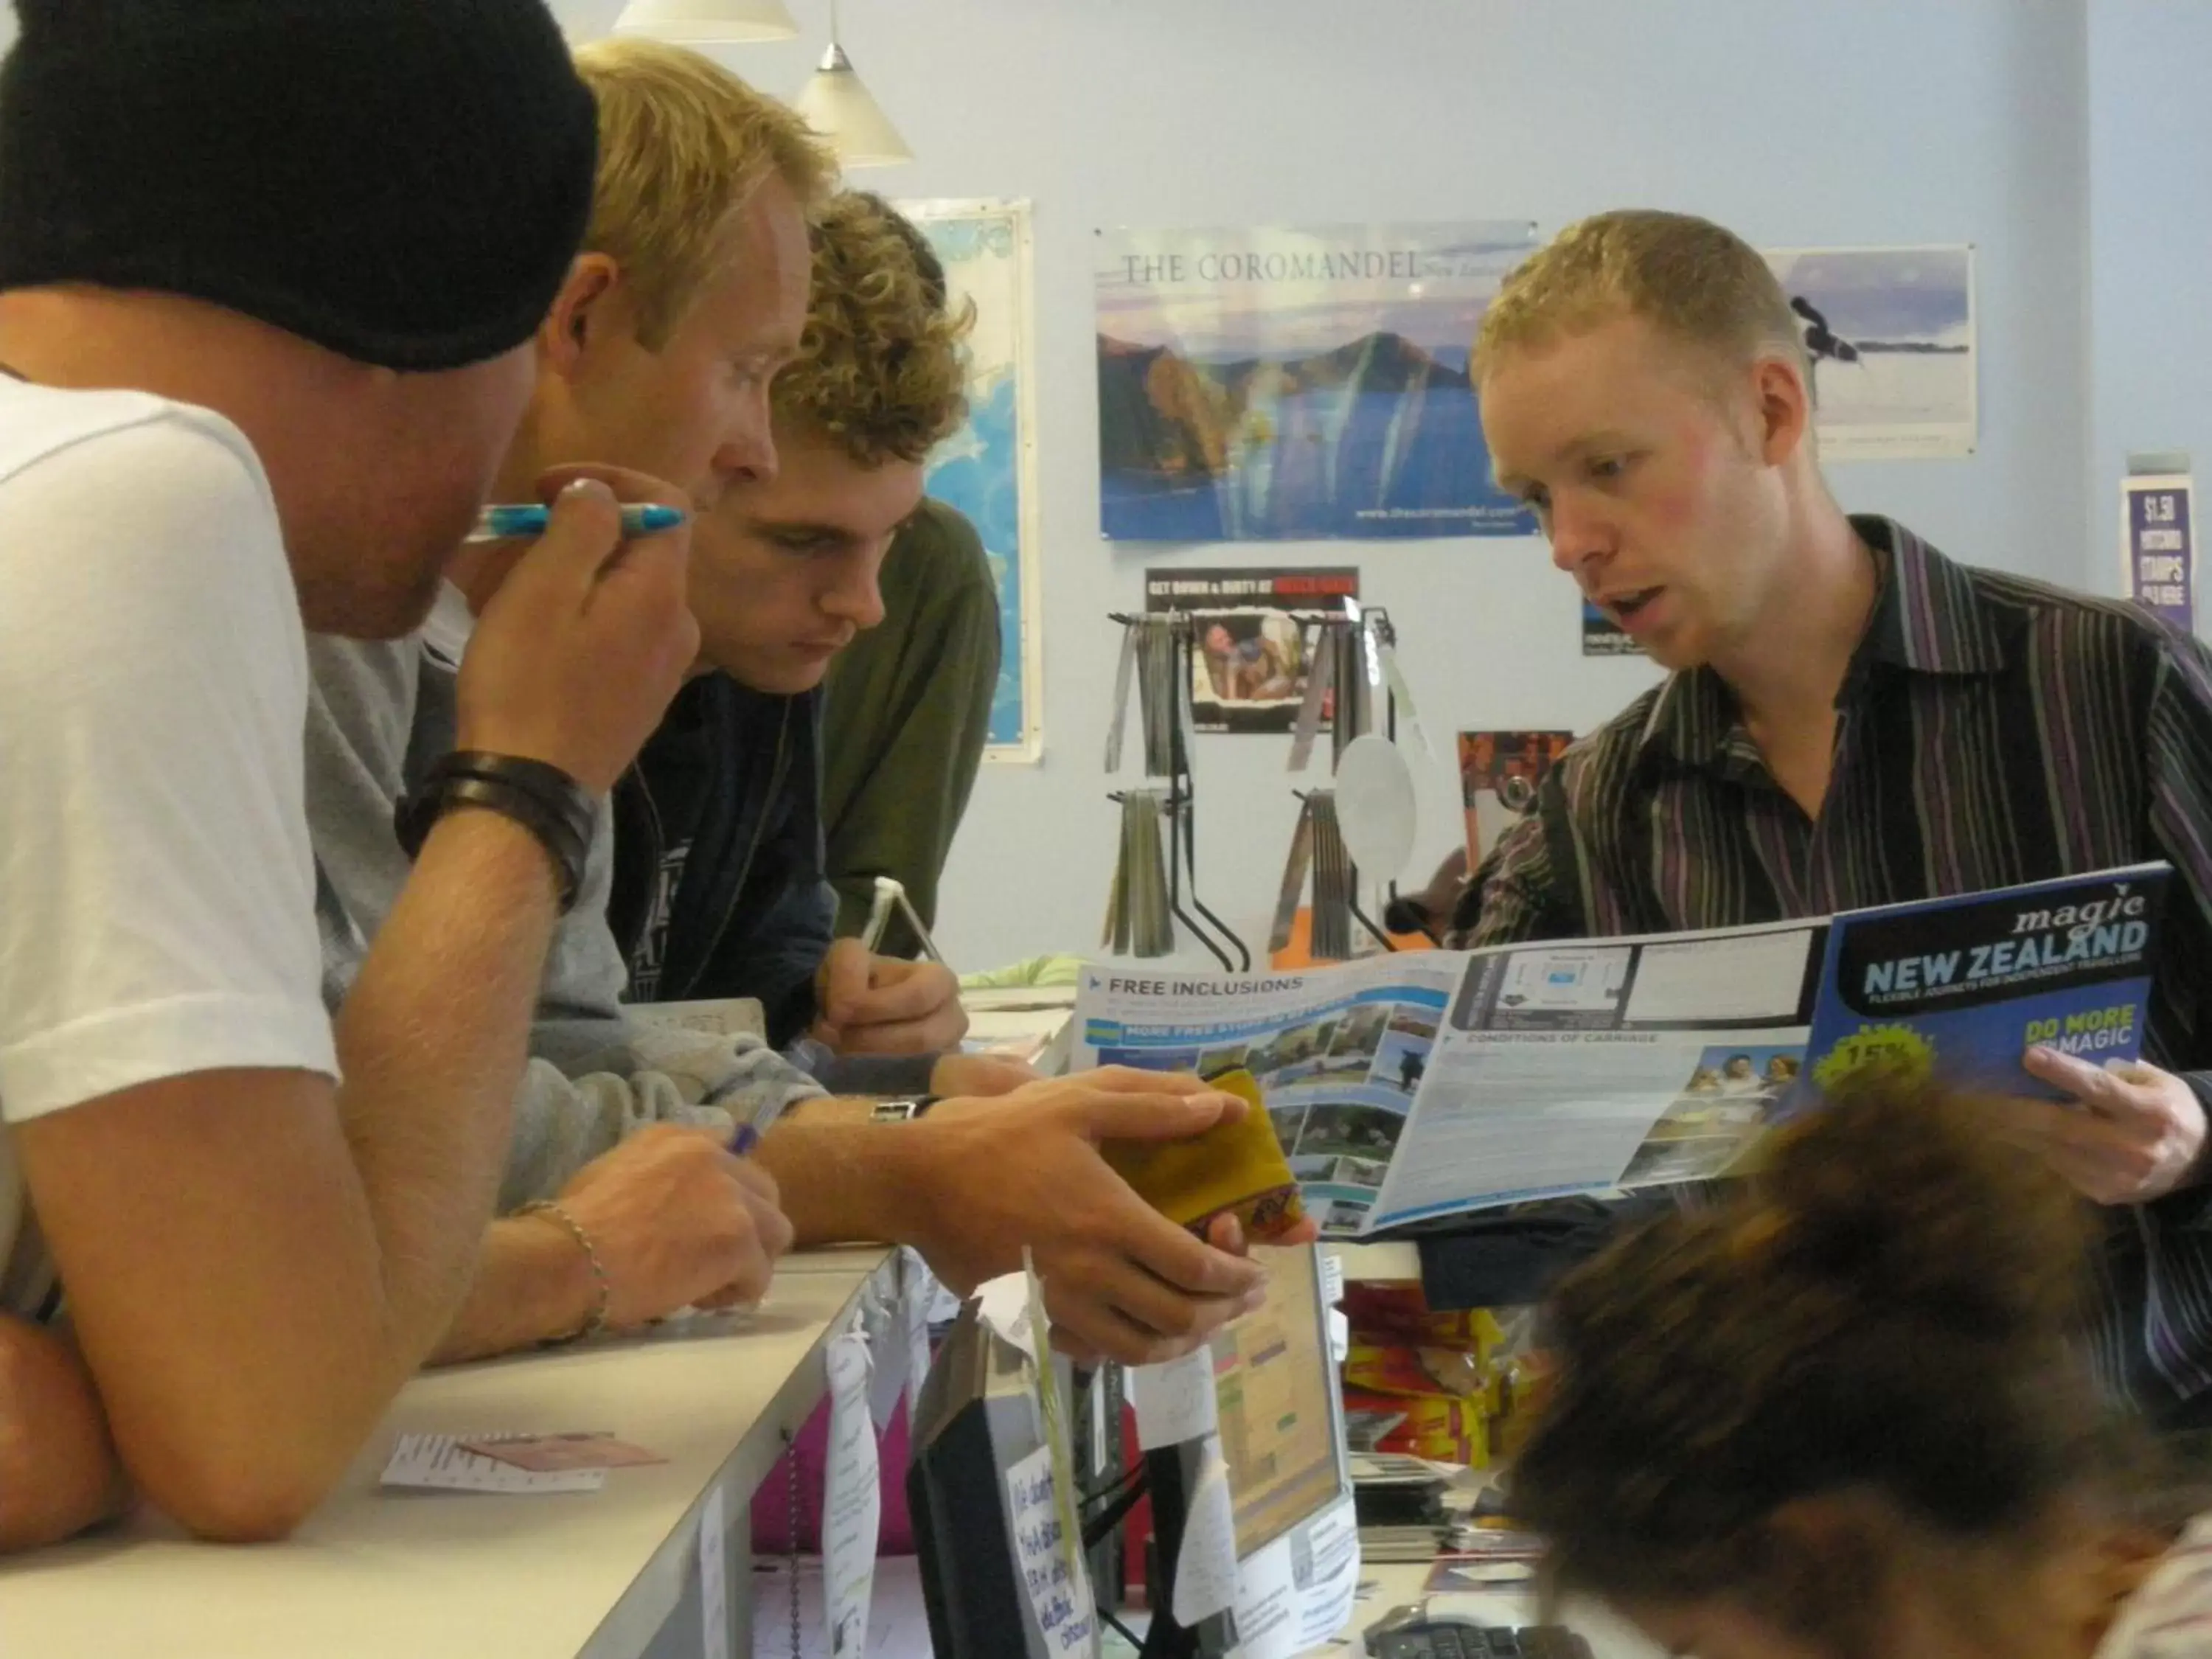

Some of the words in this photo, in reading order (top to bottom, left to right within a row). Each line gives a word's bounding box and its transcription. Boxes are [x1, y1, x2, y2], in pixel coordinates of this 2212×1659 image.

[1121, 254, 1186, 282] THE
[1198, 251, 1421, 282] COROMANDEL
[2011, 883, 2145, 941] magic
[1864, 951, 1961, 995] NEW
[1966, 920, 2149, 980] ZEALAND
[1109, 978, 1166, 995] FREE
[1174, 977, 1304, 995] INCLUSIONS
[1467, 1033, 1556, 1043] CONDITIONS
[1561, 1033, 1578, 1043] OF
[2025, 1018, 2059, 1043] DO
[2066, 1004, 2136, 1034] MORE
[2058, 1026, 2132, 1054] MAGIC
